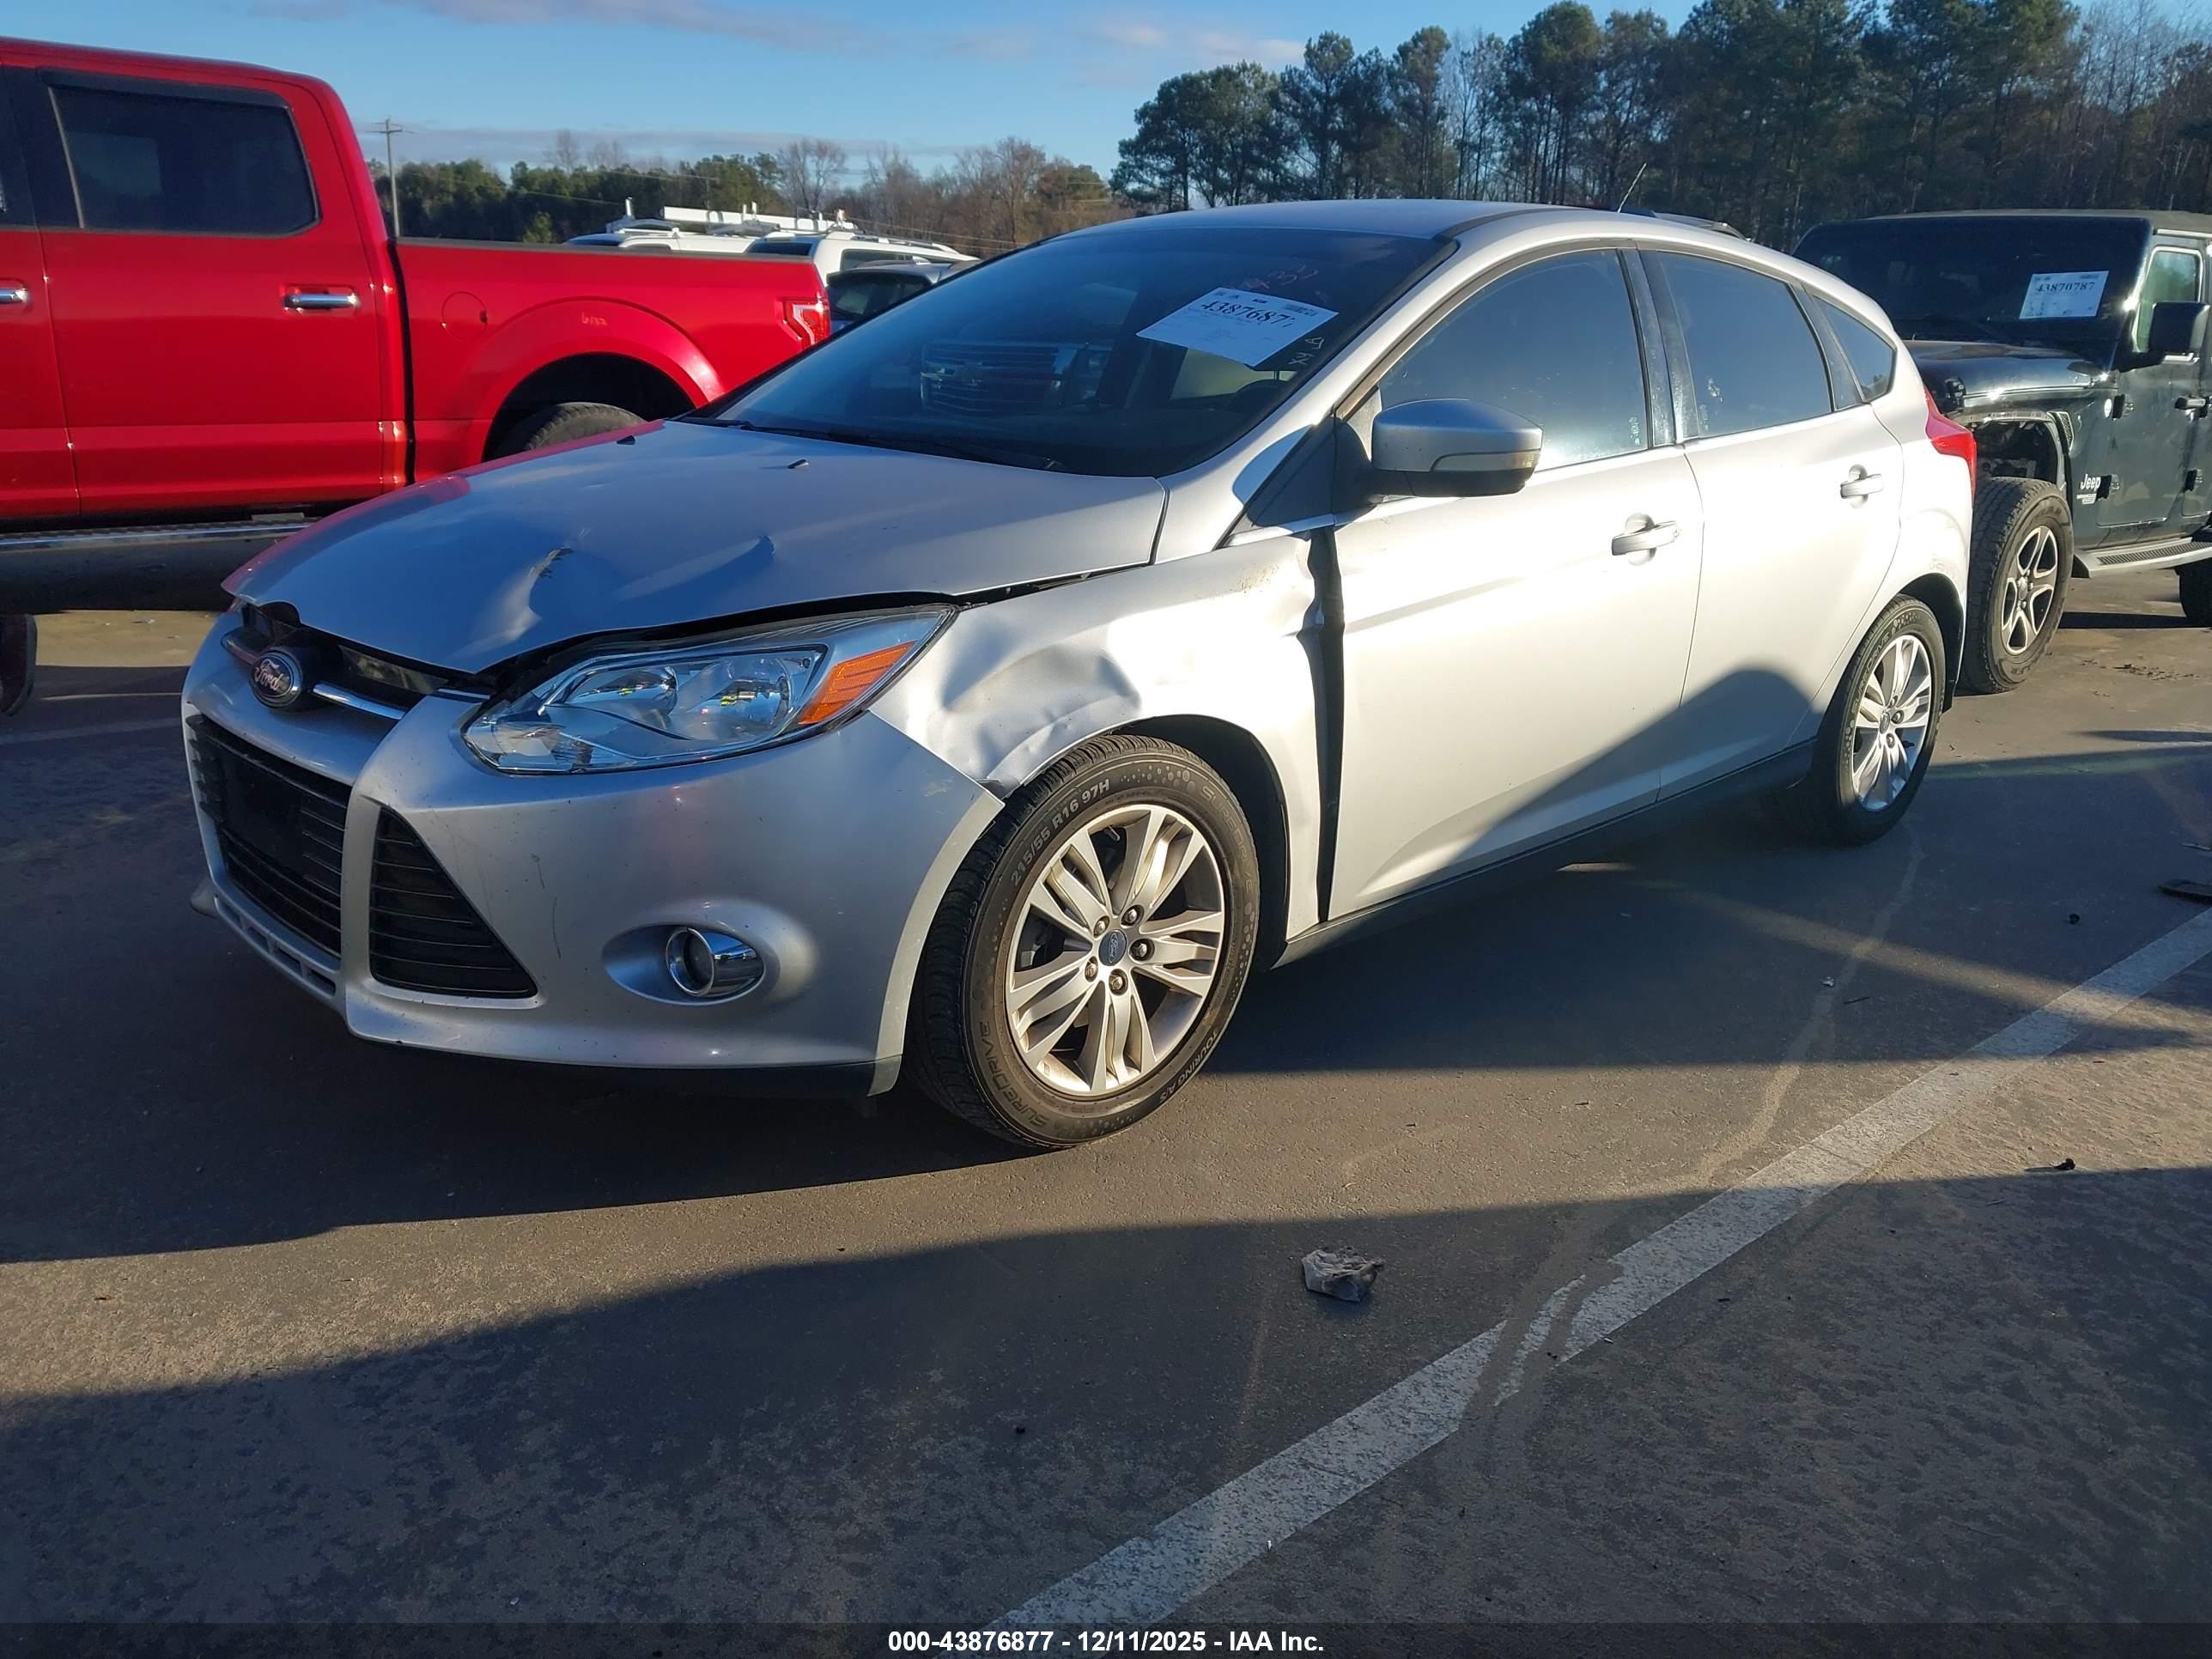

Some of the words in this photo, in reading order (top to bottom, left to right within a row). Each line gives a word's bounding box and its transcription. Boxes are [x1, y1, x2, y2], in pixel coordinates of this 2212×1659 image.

[2036, 282, 2096, 292] 43870787
[1201, 301, 1296, 328] 43876877
[2080, 473, 2101, 491] Jeep
[253, 658, 283, 690] Ford
[1011, 826, 1052, 887] 215/55
[1052, 799, 1080, 830] R16
[1081, 779, 1110, 805] 97H
[1178, 1030, 1218, 1085] TOURING
[978, 1020, 1050, 1128] SUREDRIVE
